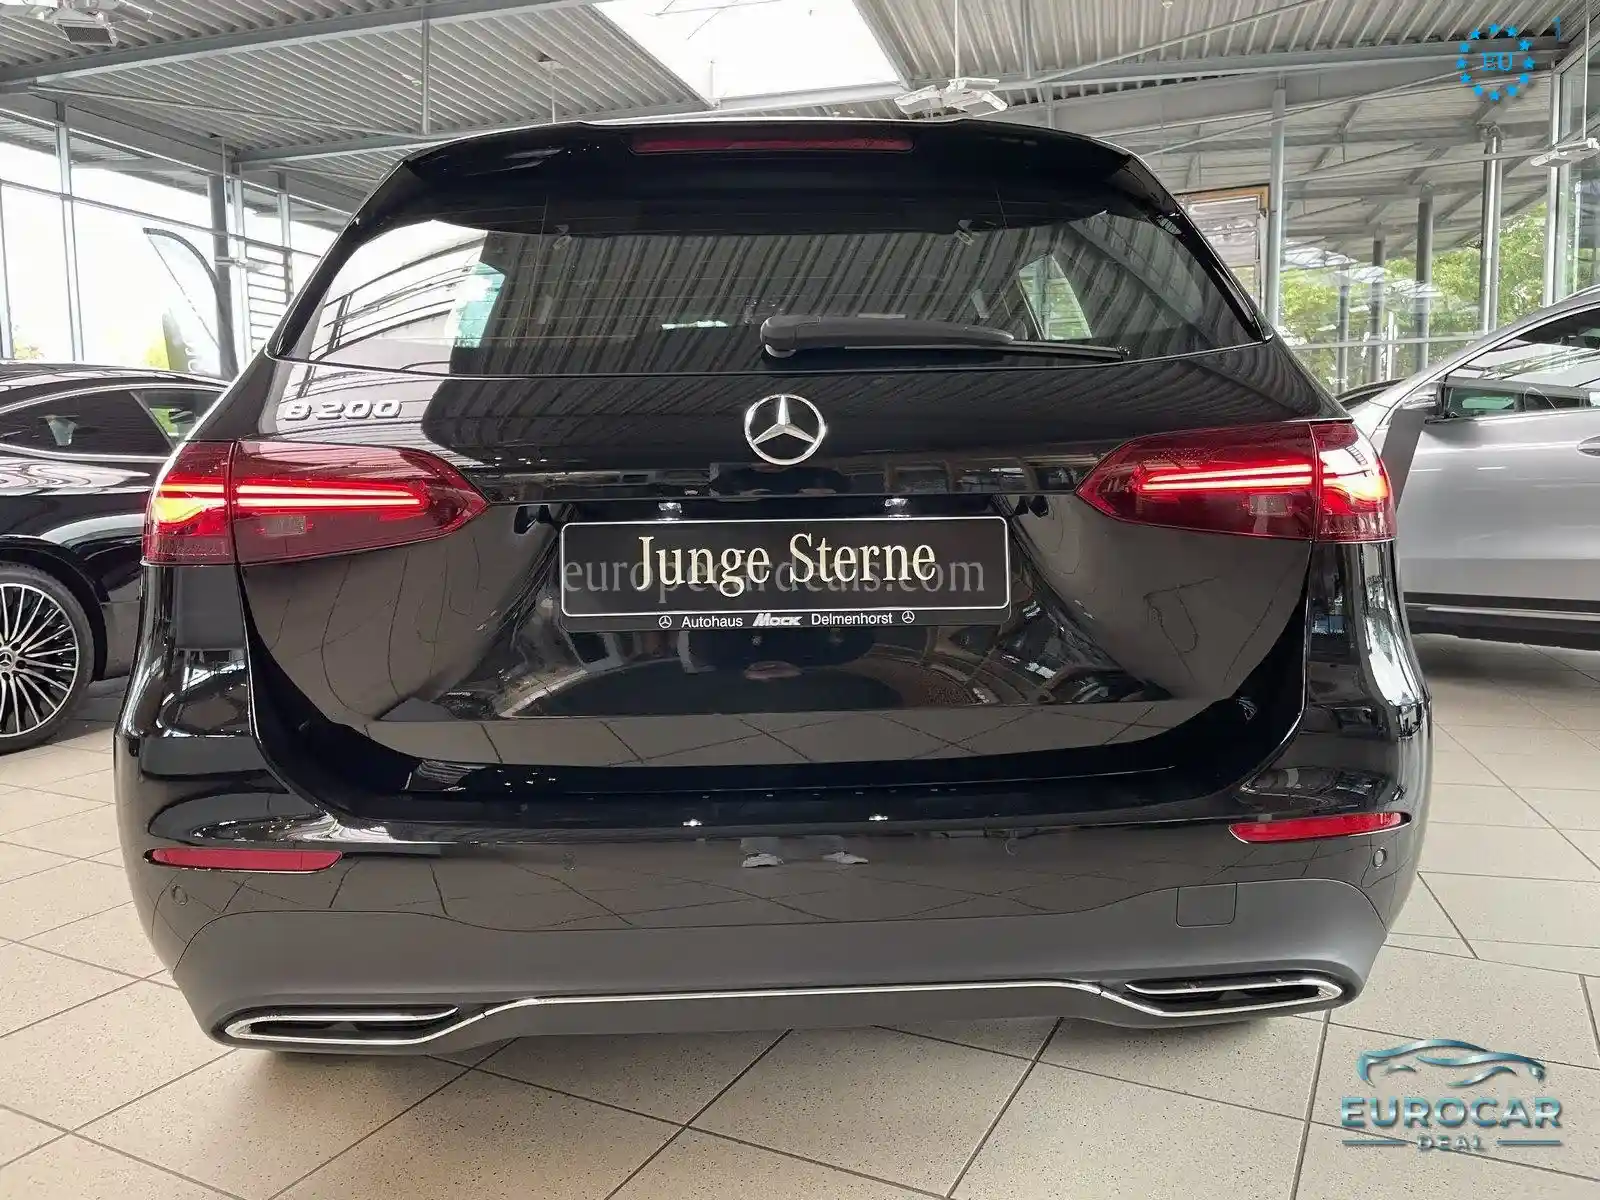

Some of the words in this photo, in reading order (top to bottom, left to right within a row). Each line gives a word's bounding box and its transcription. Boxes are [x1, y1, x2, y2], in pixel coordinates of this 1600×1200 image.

[315, 400, 402, 419] 200
[637, 536, 770, 597] Junge
[789, 533, 936, 583] Sterne
[681, 615, 744, 628] Autohaus
[811, 612, 893, 626] Delmenhorst
